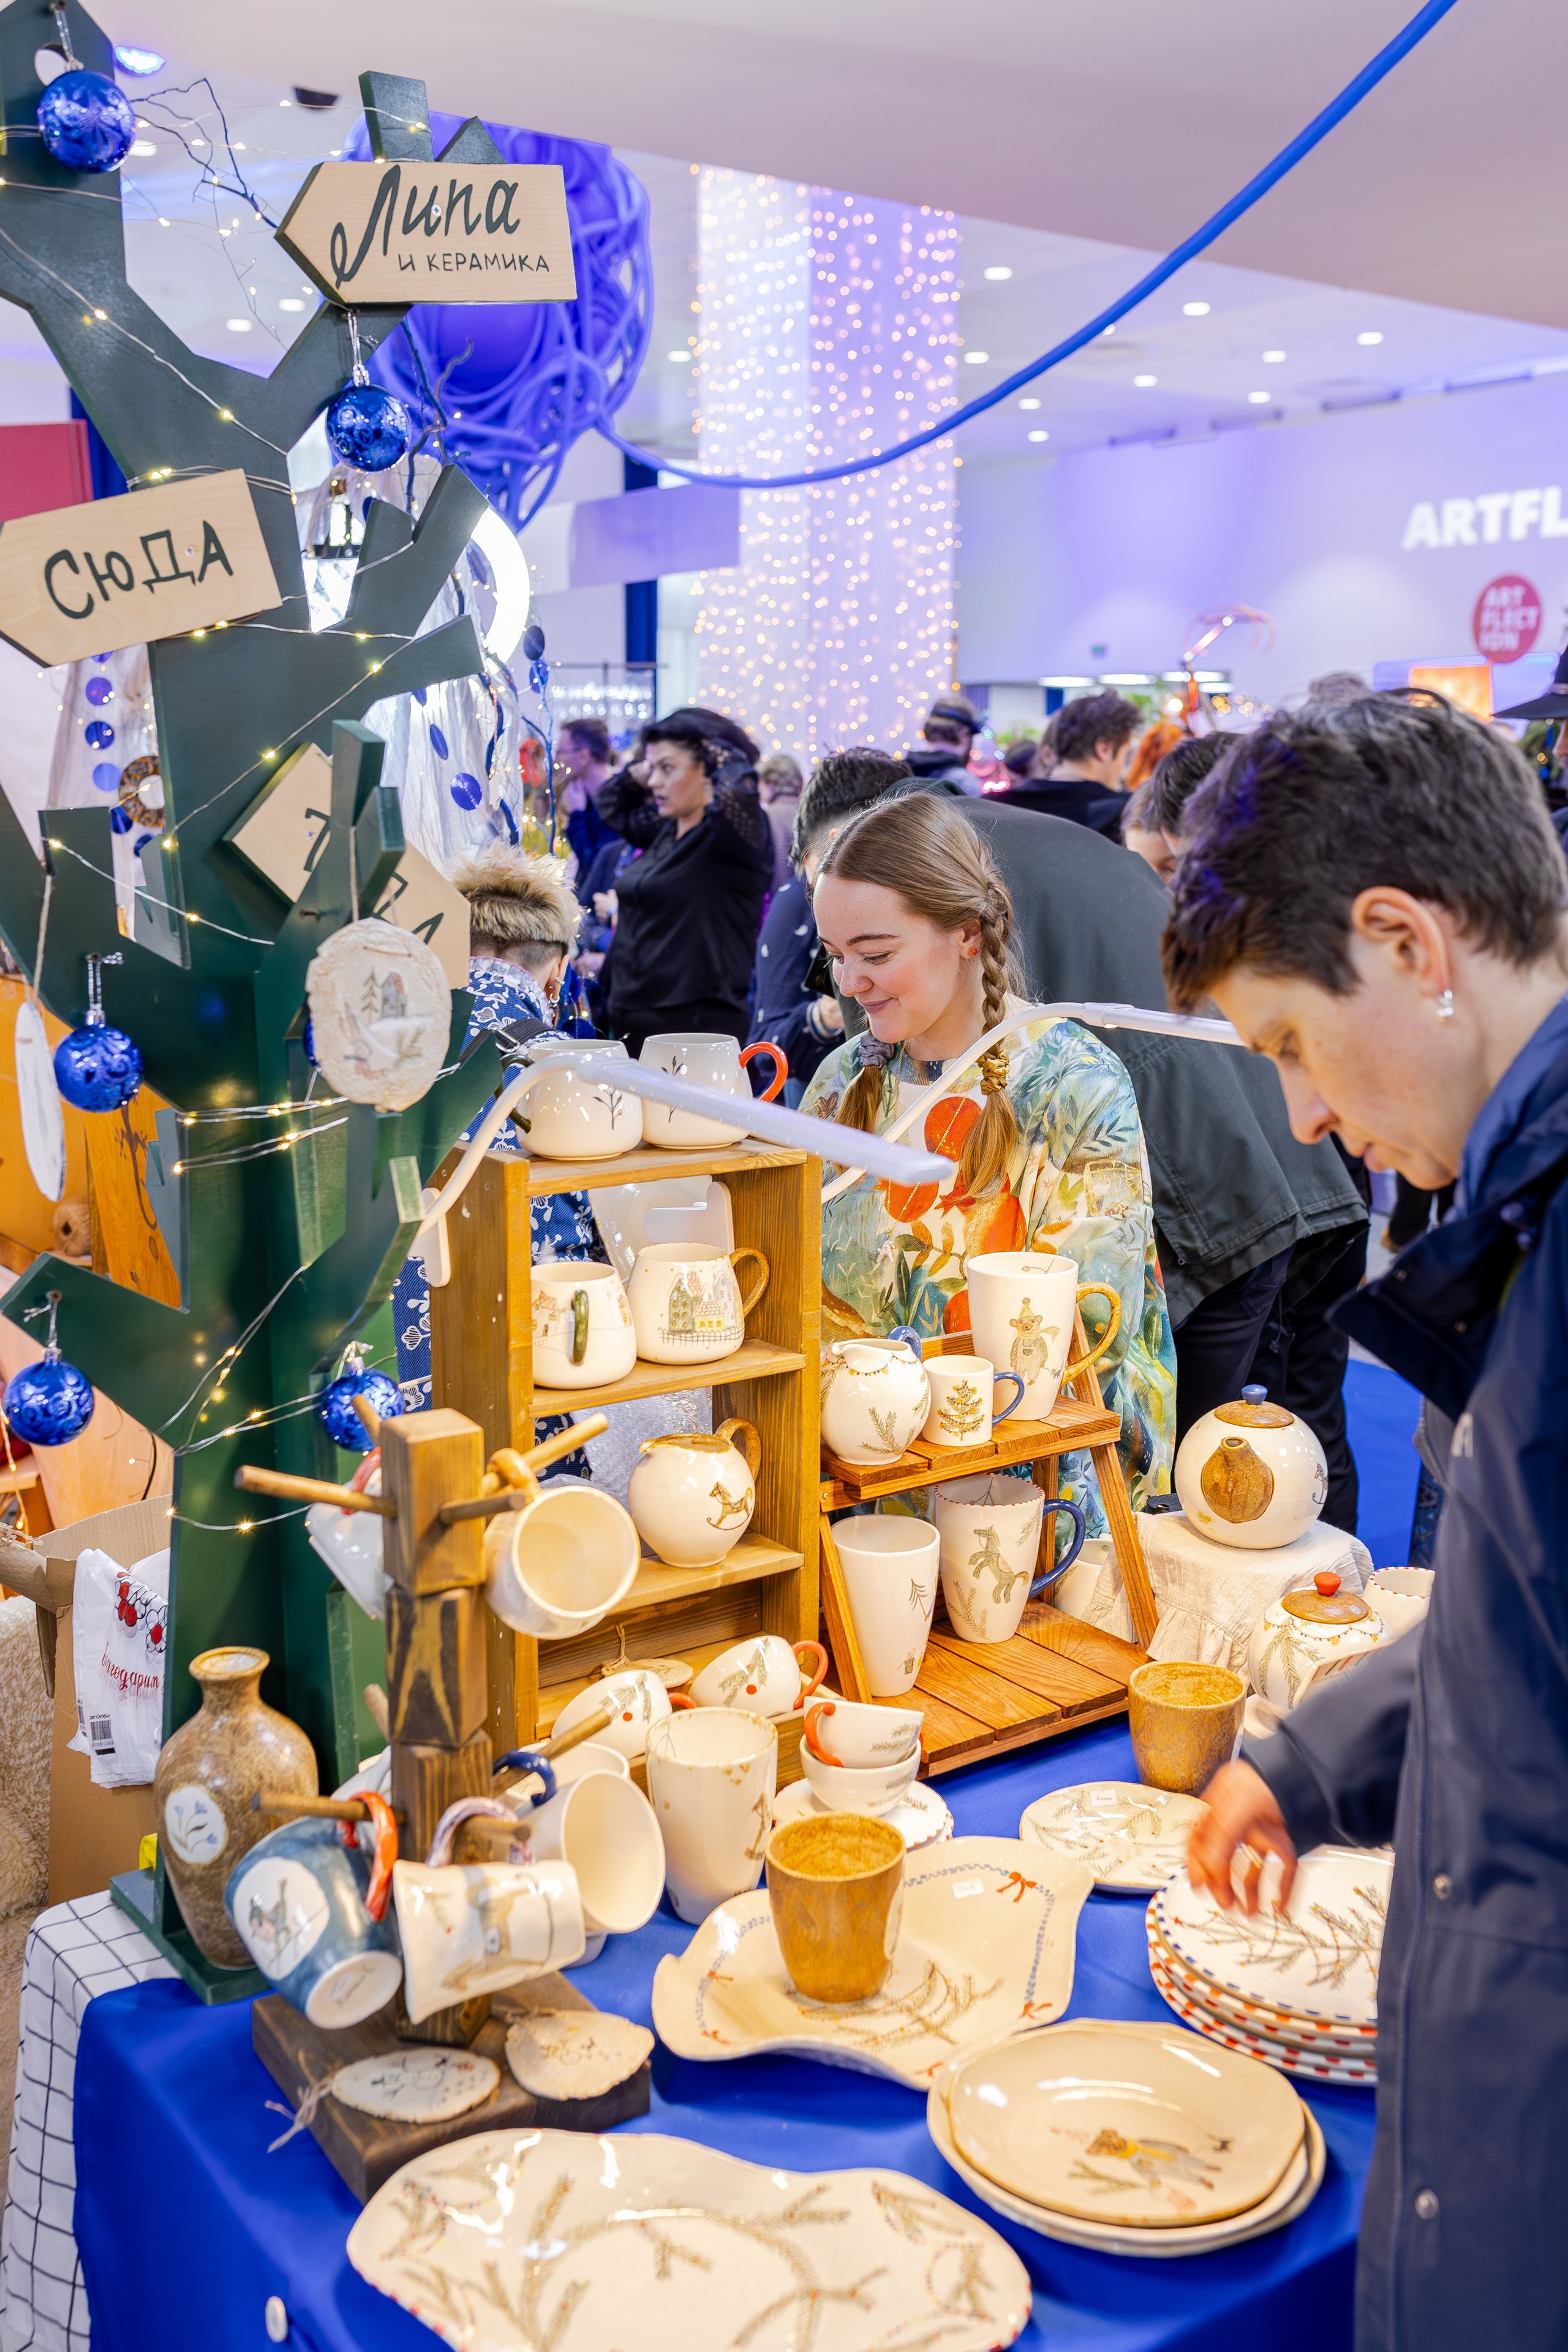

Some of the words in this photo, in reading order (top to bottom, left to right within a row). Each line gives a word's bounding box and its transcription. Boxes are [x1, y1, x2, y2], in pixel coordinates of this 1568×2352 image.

[330, 164, 520, 290] Липа
[427, 253, 549, 273] КЕРАМИКА
[1401, 485, 1568, 551] ARTFL
[43, 519, 233, 619] СЮДА
[1483, 584, 1527, 606] ART
